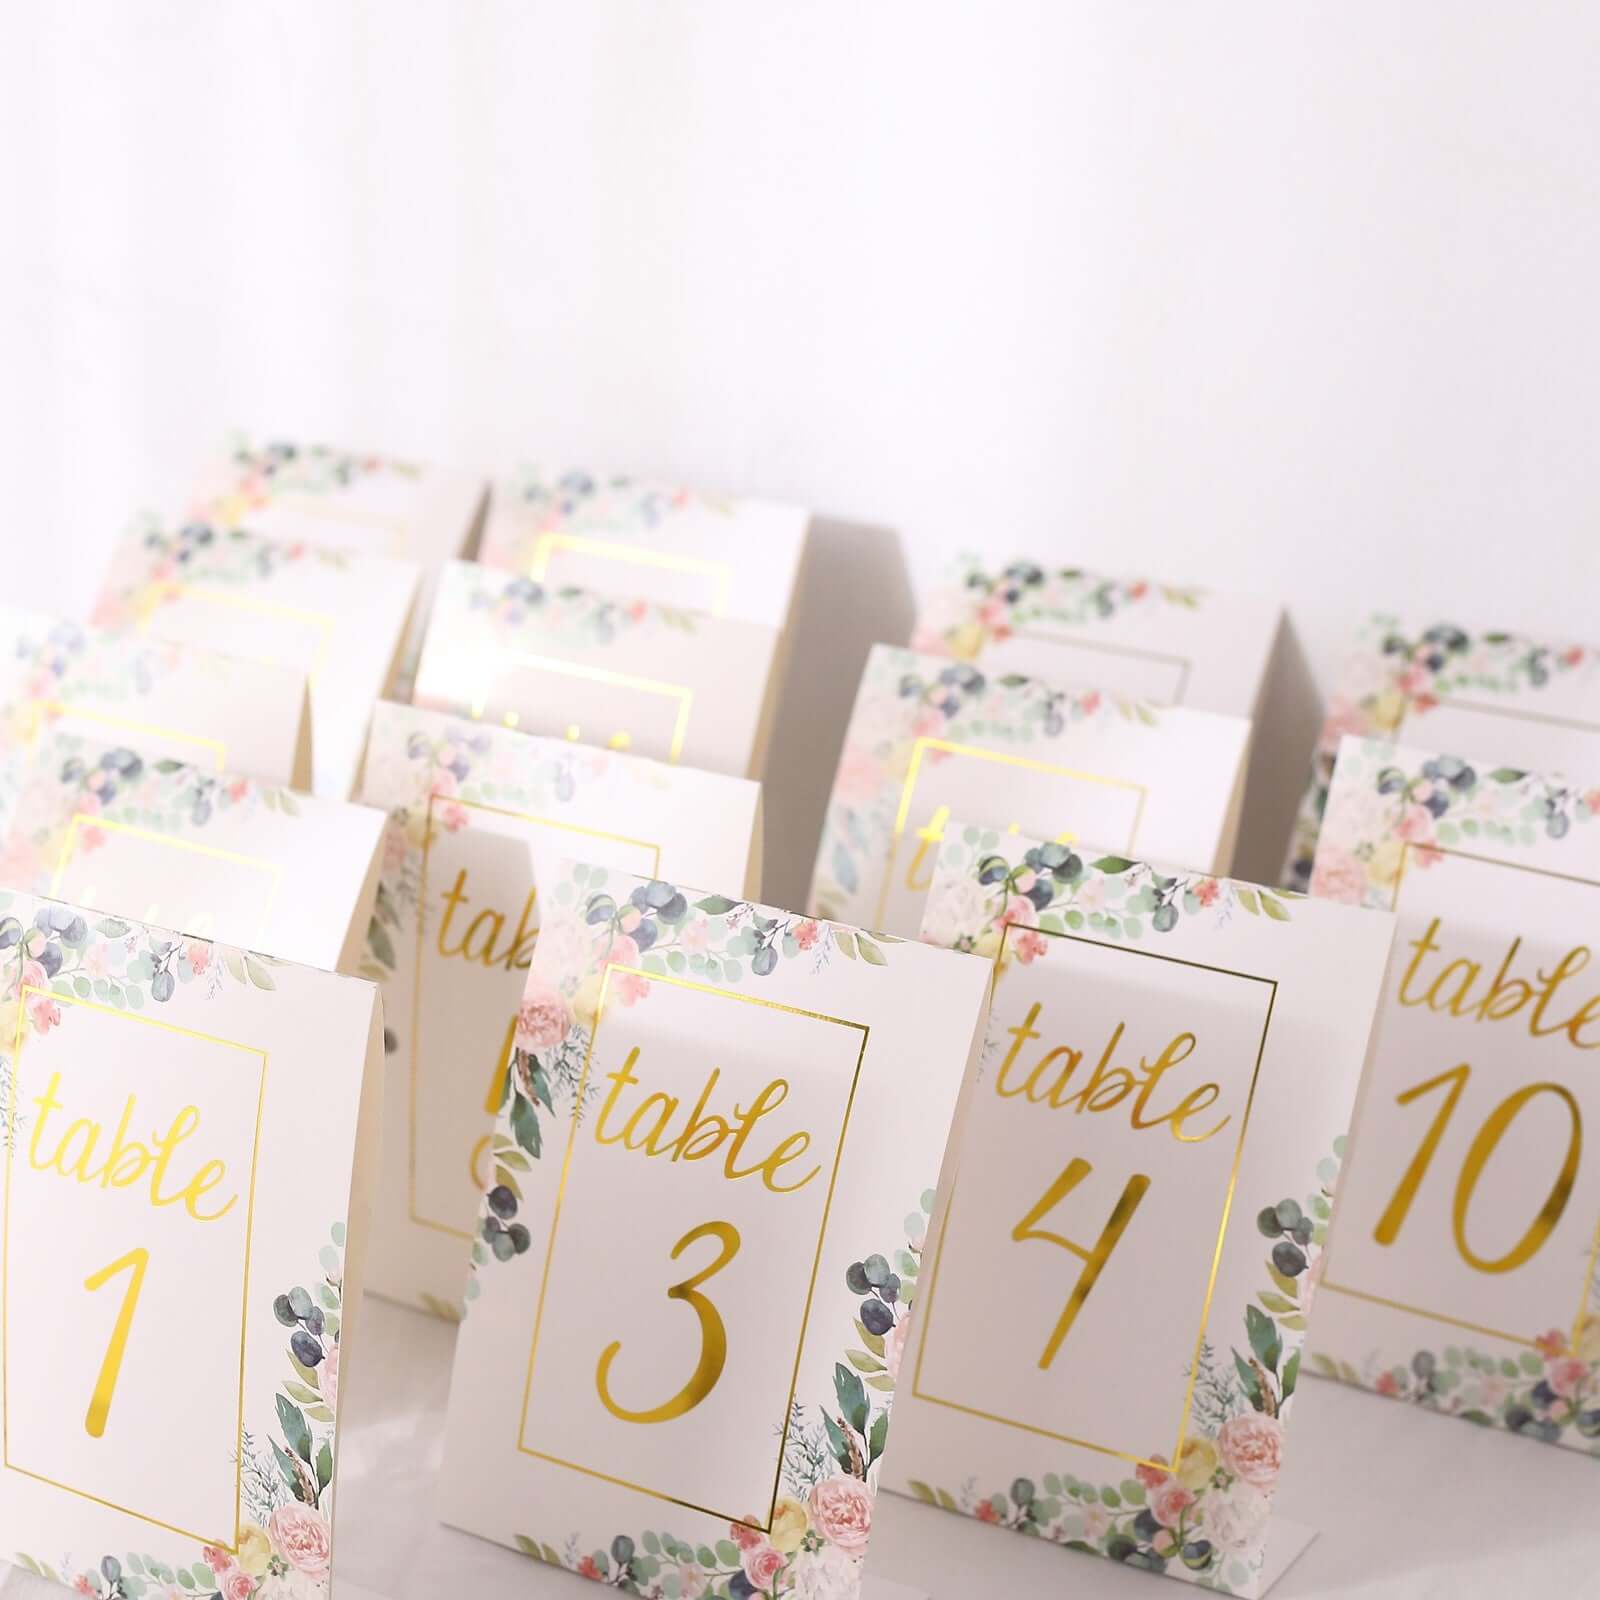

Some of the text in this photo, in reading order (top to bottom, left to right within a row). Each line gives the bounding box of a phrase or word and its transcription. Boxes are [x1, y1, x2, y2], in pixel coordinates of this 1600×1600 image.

[436, 868, 539, 972] tab
[27, 1071, 238, 1222] table
[594, 1046, 821, 1194] table
[995, 1002, 1231, 1143] table
[1371, 1062, 1583, 1275] 10
[84, 1247, 150, 1439] 1
[594, 1220, 741, 1424] 3
[1011, 1157, 1152, 1371] 4
